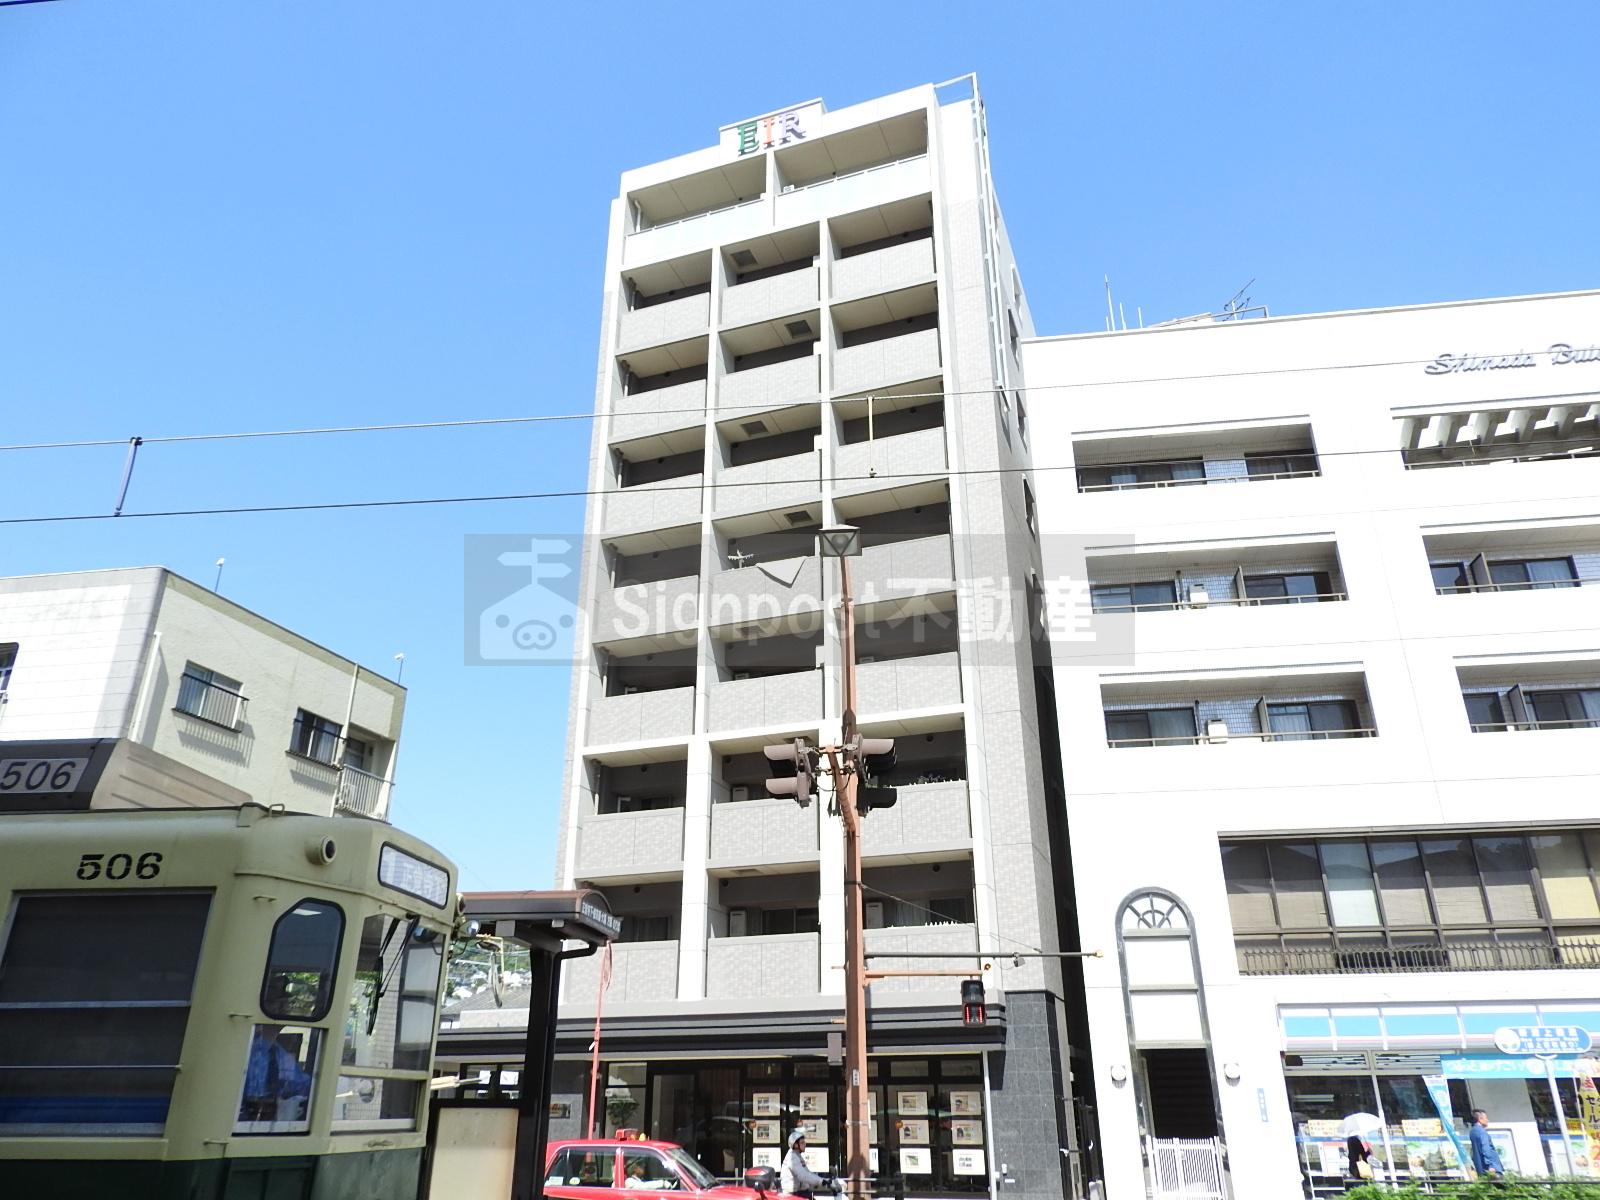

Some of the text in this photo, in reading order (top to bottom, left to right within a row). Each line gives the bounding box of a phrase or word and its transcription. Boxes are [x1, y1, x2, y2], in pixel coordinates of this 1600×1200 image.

[736, 111, 807, 157] EIR
[0, 760, 76, 791] 506
[76, 852, 163, 880] 506
